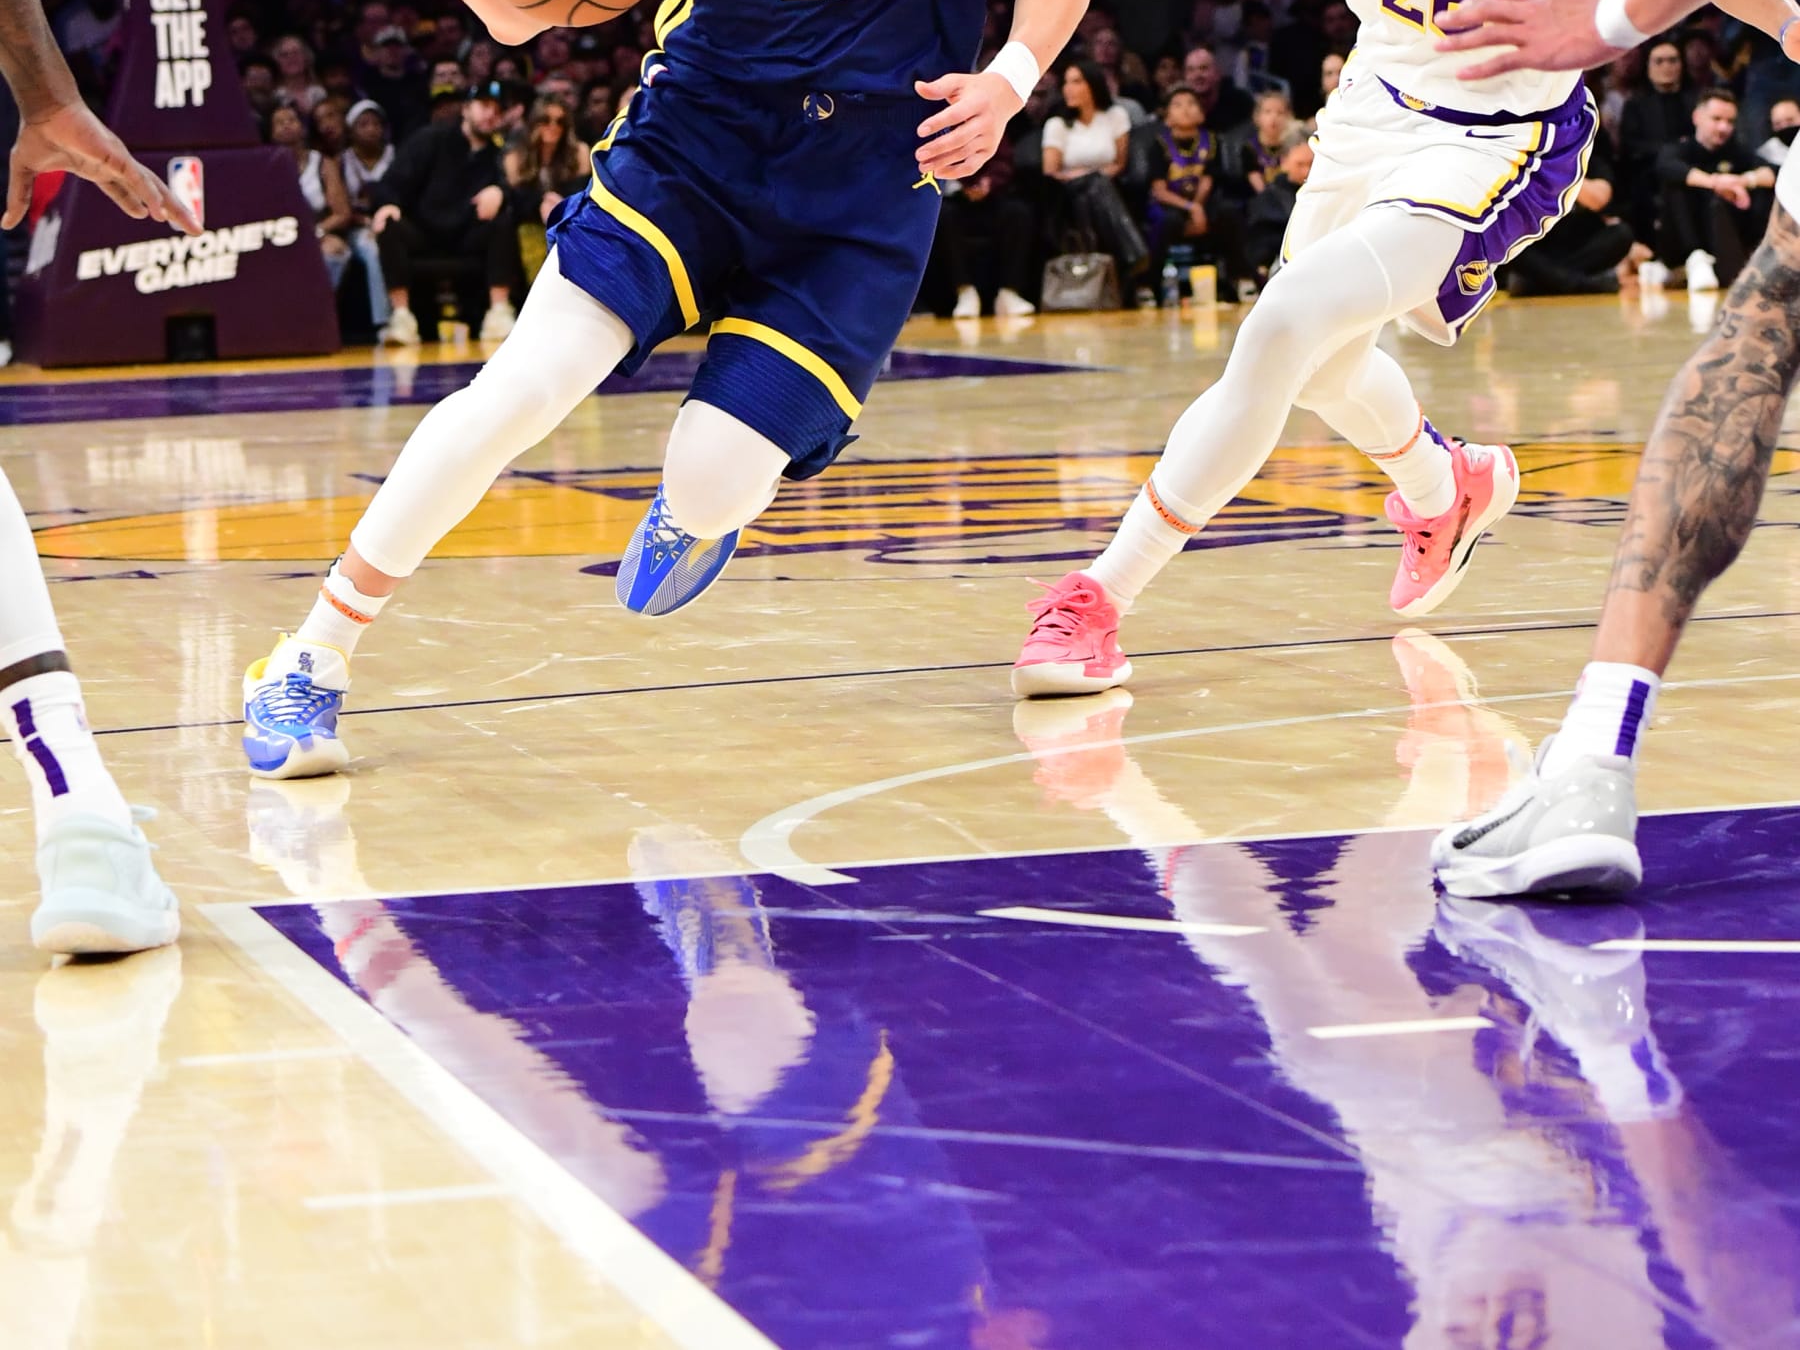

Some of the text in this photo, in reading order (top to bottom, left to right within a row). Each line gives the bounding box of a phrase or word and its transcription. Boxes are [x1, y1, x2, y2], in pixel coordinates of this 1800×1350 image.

[151, 10, 209, 60] THE
[155, 59, 212, 108] APP
[76, 216, 298, 280] EVERYONE'S
[134, 253, 239, 294] GAME
